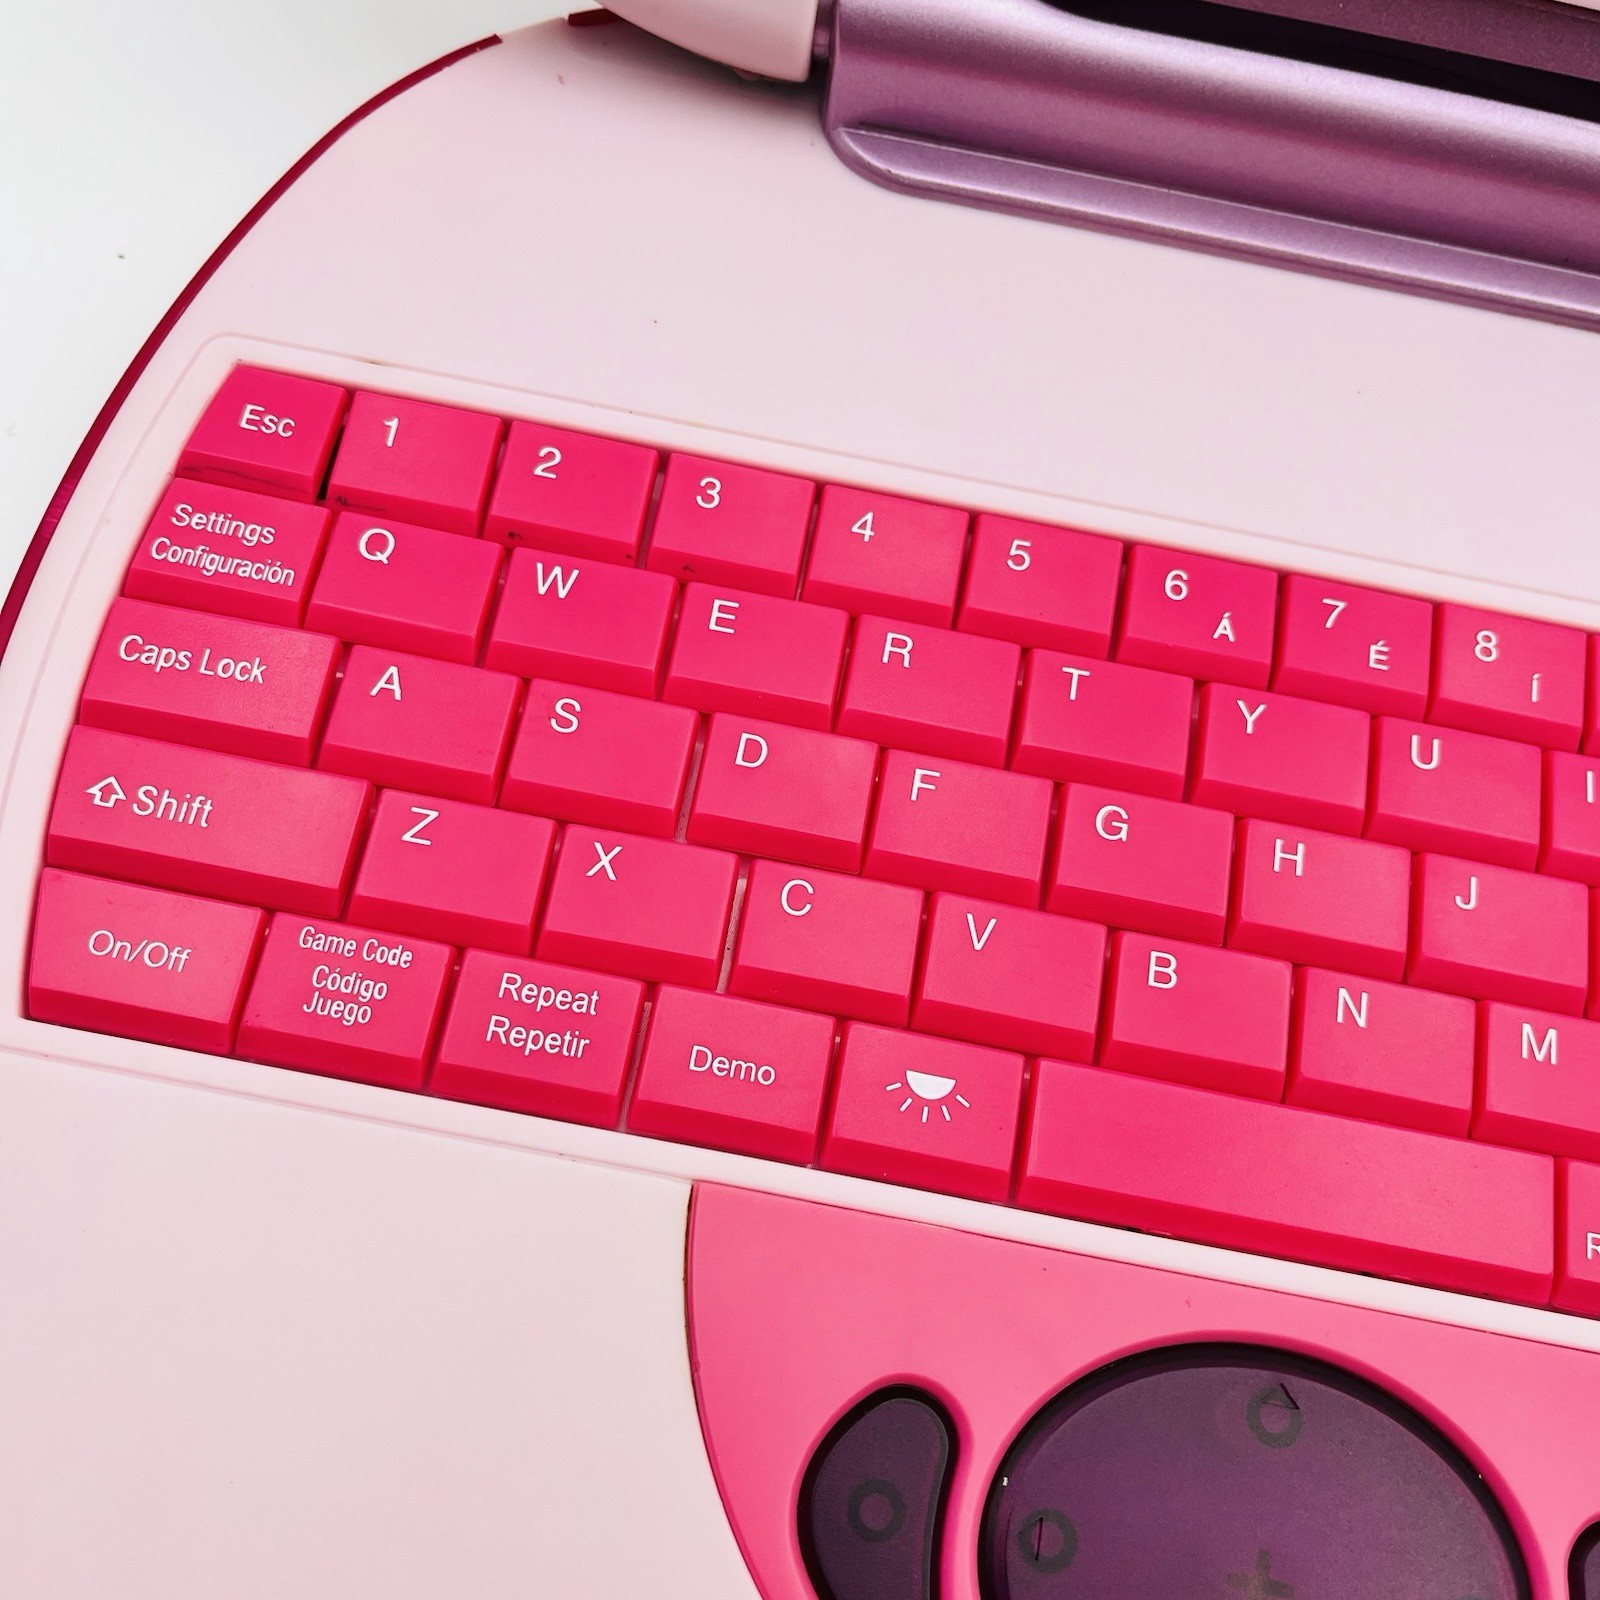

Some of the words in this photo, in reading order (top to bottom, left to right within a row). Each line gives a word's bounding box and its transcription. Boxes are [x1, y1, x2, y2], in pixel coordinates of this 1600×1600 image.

[239, 403, 296, 438] Esc
[383, 417, 399, 448] 1
[533, 446, 562, 479] 2
[695, 476, 722, 509] 3
[171, 503, 276, 547] Settings
[850, 511, 875, 543] 4
[151, 536, 295, 589] Configuración
[358, 527, 396, 565] Q
[1006, 539, 1032, 571] 5
[536, 562, 580, 599] W
[1164, 569, 1188, 601] 6
[708, 598, 740, 635] E
[1212, 611, 1235, 643] Á
[1322, 598, 1346, 629] 7
[118, 634, 193, 677] Caps
[198, 648, 268, 685] Lock
[882, 631, 914, 669] R
[1368, 640, 1390, 671] É
[1474, 629, 1500, 663] 8
[369, 665, 402, 701] A
[1061, 666, 1091, 701] T
[550, 697, 581, 734] S
[1236, 699, 1267, 735] Y
[734, 732, 768, 768] D
[1410, 734, 1441, 770] U
[910, 767, 941, 802] F
[131, 785, 214, 830] Shift
[401, 806, 440, 846] Z
[1095, 804, 1129, 843] G
[585, 841, 623, 881] X
[1273, 838, 1306, 877] H
[780, 879, 814, 917] C
[1454, 875, 1479, 911] J
[298, 925, 357, 961] Game
[361, 938, 413, 969] Code
[966, 912, 998, 951] V
[87, 929, 193, 974] On/Off
[1147, 950, 1178, 990] B
[311, 964, 388, 1003] Código
[498, 972, 600, 1021] Repeat
[302, 990, 372, 1027] Juego
[1336, 987, 1370, 1029] N
[485, 1014, 591, 1065] Repetir
[1521, 1022, 1558, 1066] M
[688, 1044, 776, 1087] Demo
